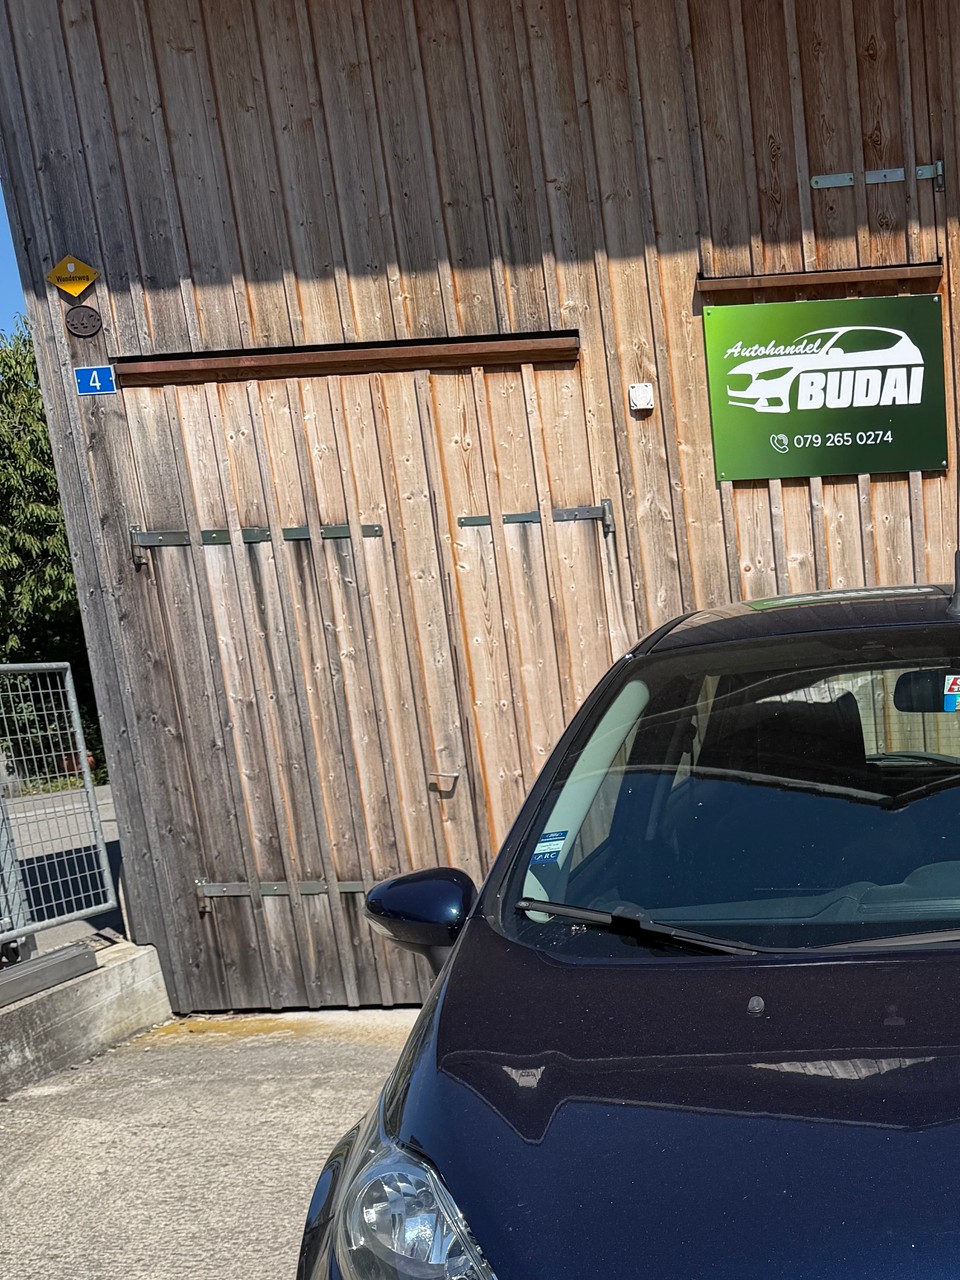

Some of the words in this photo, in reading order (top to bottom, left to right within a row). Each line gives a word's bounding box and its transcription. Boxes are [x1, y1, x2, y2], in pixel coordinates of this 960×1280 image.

[723, 338, 822, 359] Autohandel
[89, 370, 101, 391] 4
[797, 366, 925, 410] BUDAI
[794, 434, 822, 449] 079
[825, 432, 852, 447] 265
[856, 430, 893, 445] 0274
